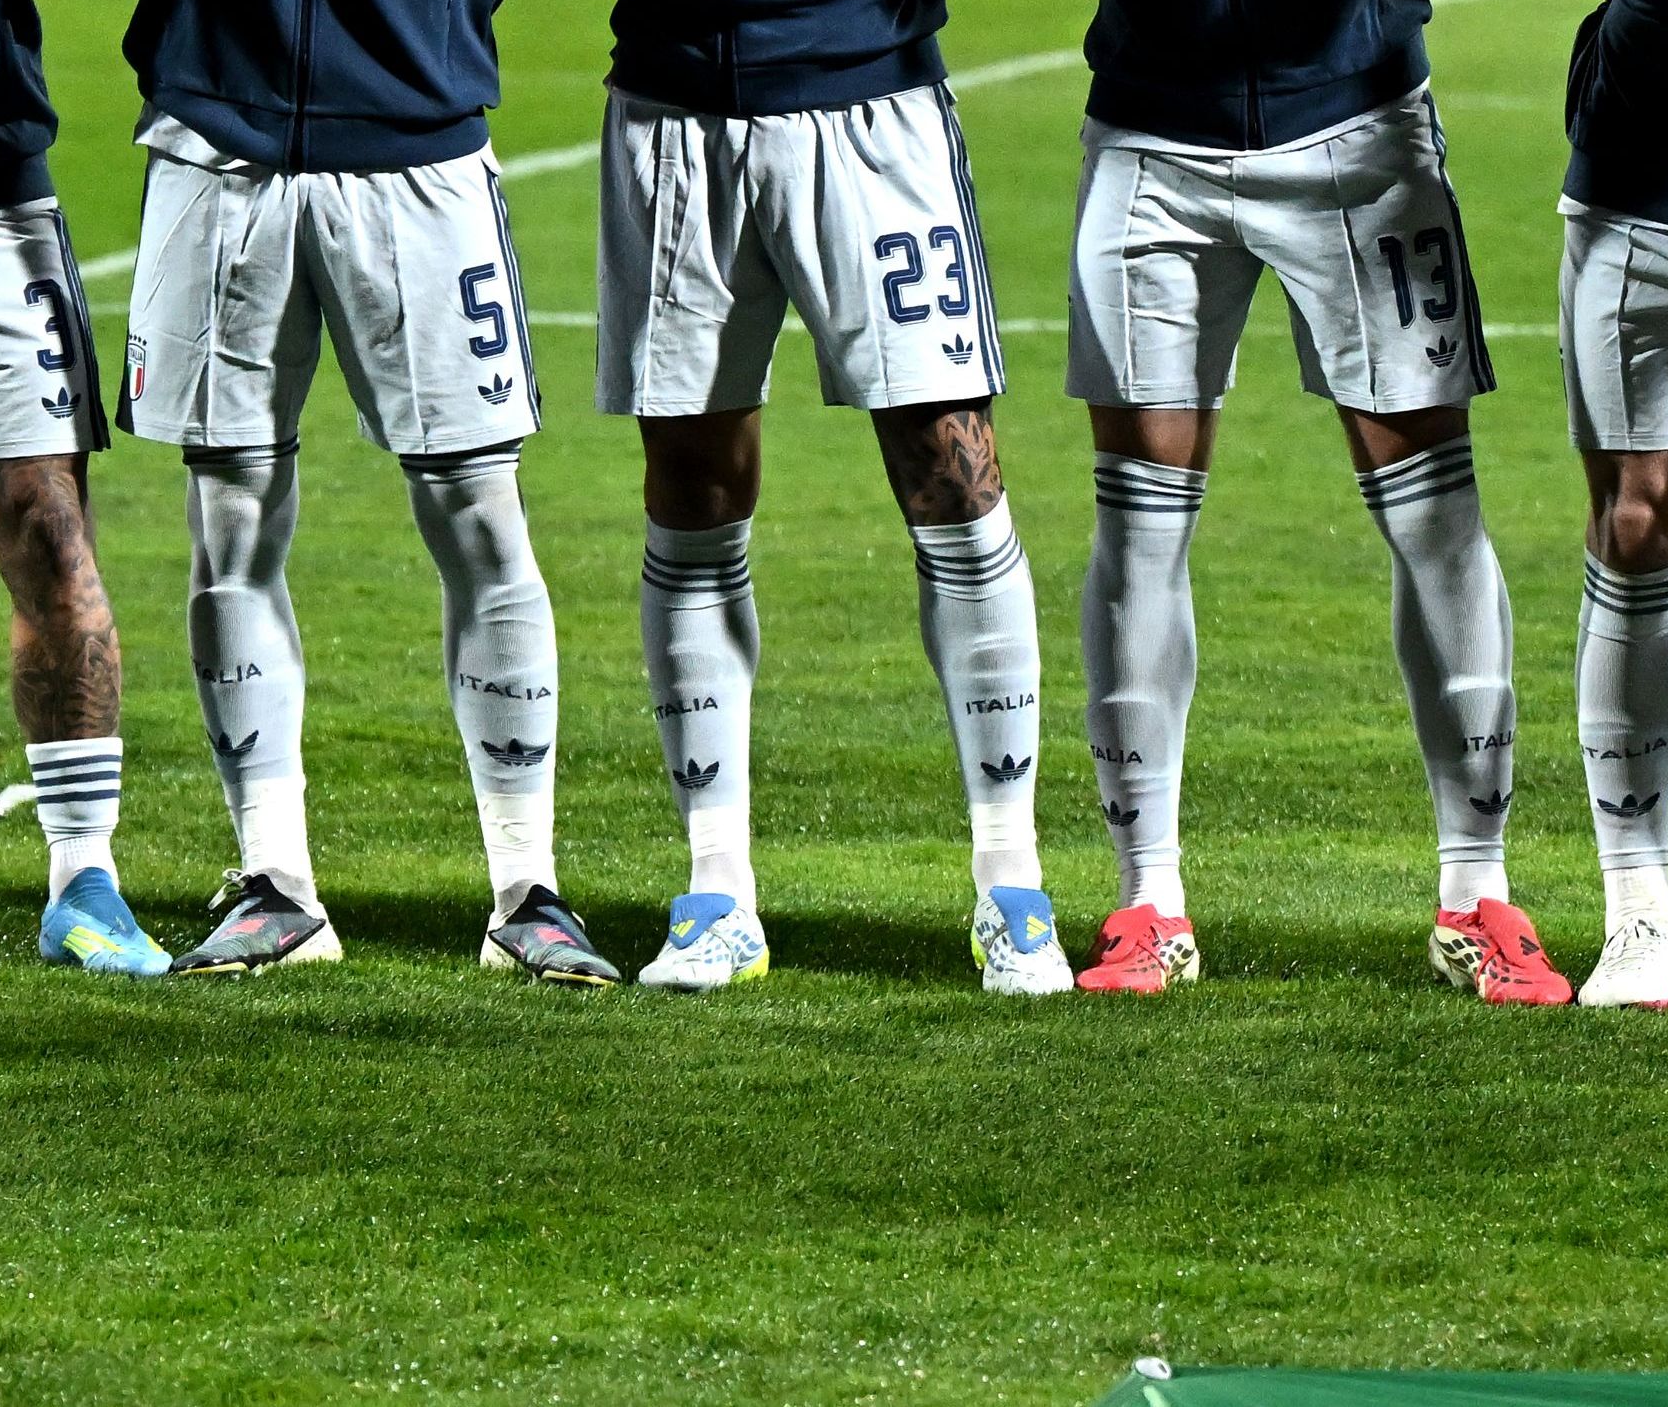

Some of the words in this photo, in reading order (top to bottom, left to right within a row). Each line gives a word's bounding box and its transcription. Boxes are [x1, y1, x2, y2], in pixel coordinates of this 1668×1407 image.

[459, 262, 509, 361] 5
[874, 225, 971, 327] 23
[1376, 225, 1458, 330] 13
[24, 279, 77, 374] 3
[460, 673, 552, 700] ITALIA
[966, 693, 1035, 715] ITALIA
[1462, 730, 1514, 752] ITALI
